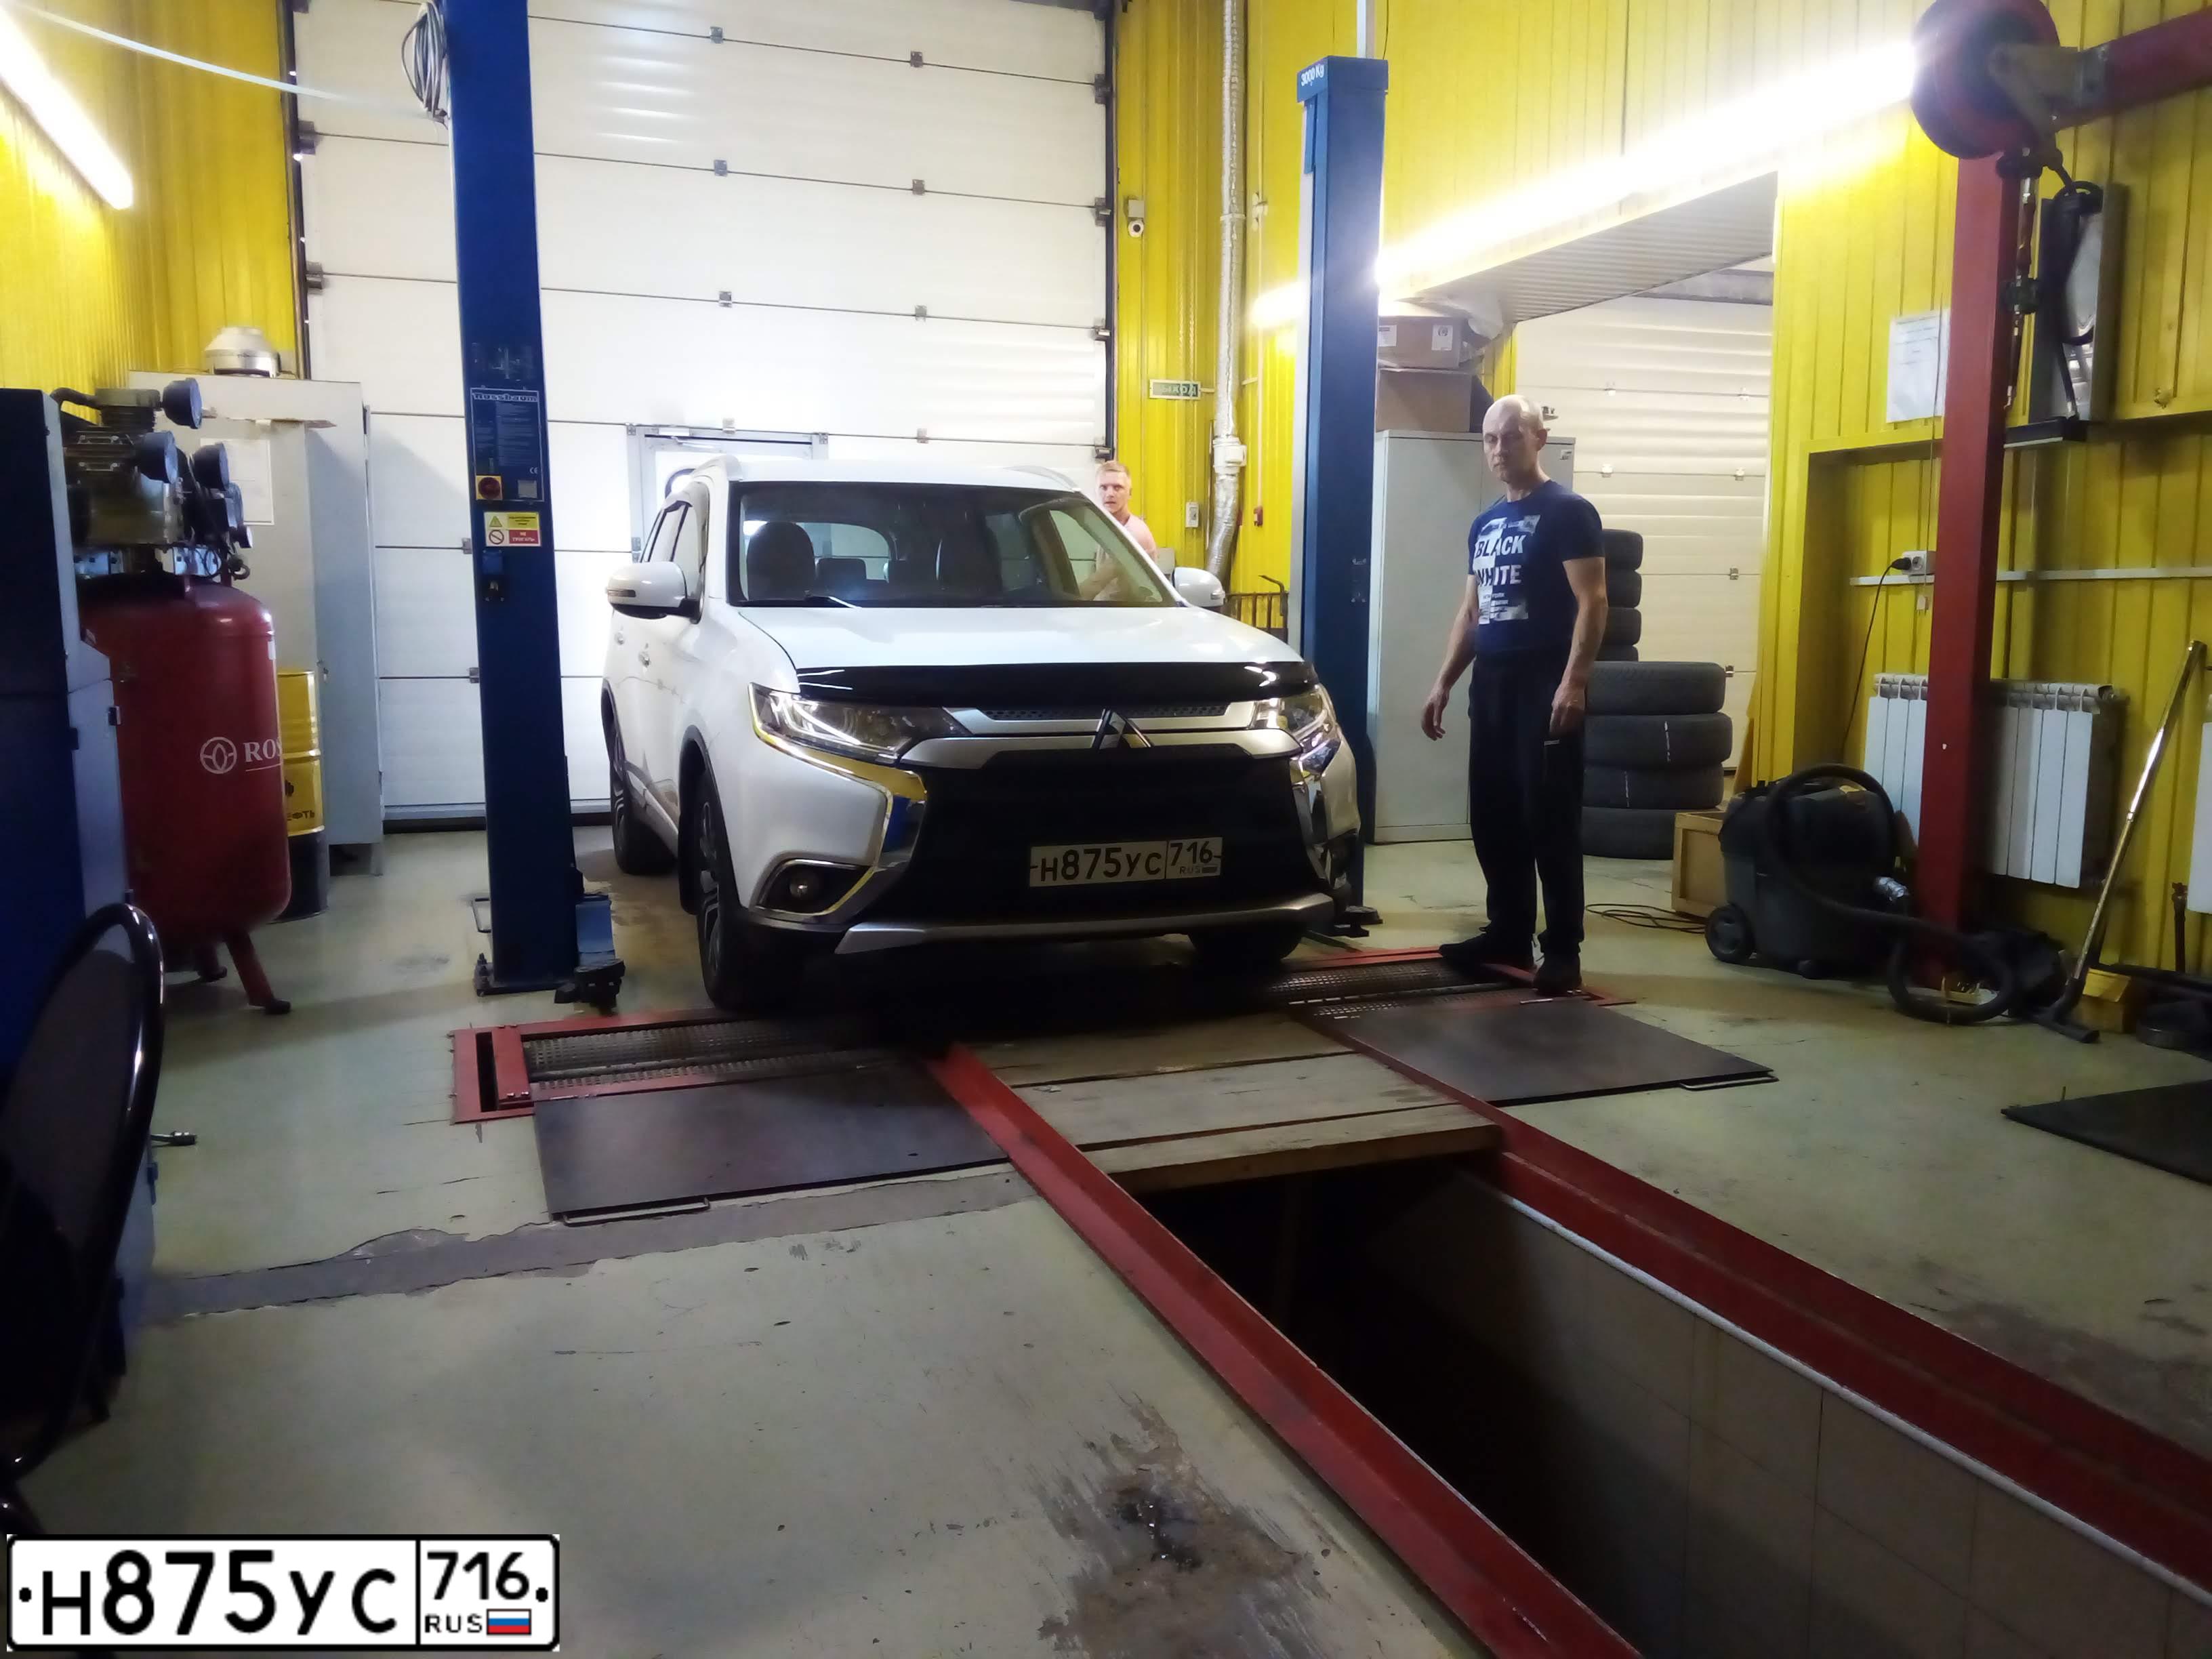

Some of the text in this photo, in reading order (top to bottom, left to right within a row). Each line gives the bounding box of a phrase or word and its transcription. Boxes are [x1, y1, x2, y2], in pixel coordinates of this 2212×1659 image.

[1475, 535, 1526, 558] BLACK
[1474, 565, 1522, 587] WHITE
[1170, 841, 1214, 866] 716
[1179, 865, 1201, 874] RUS
